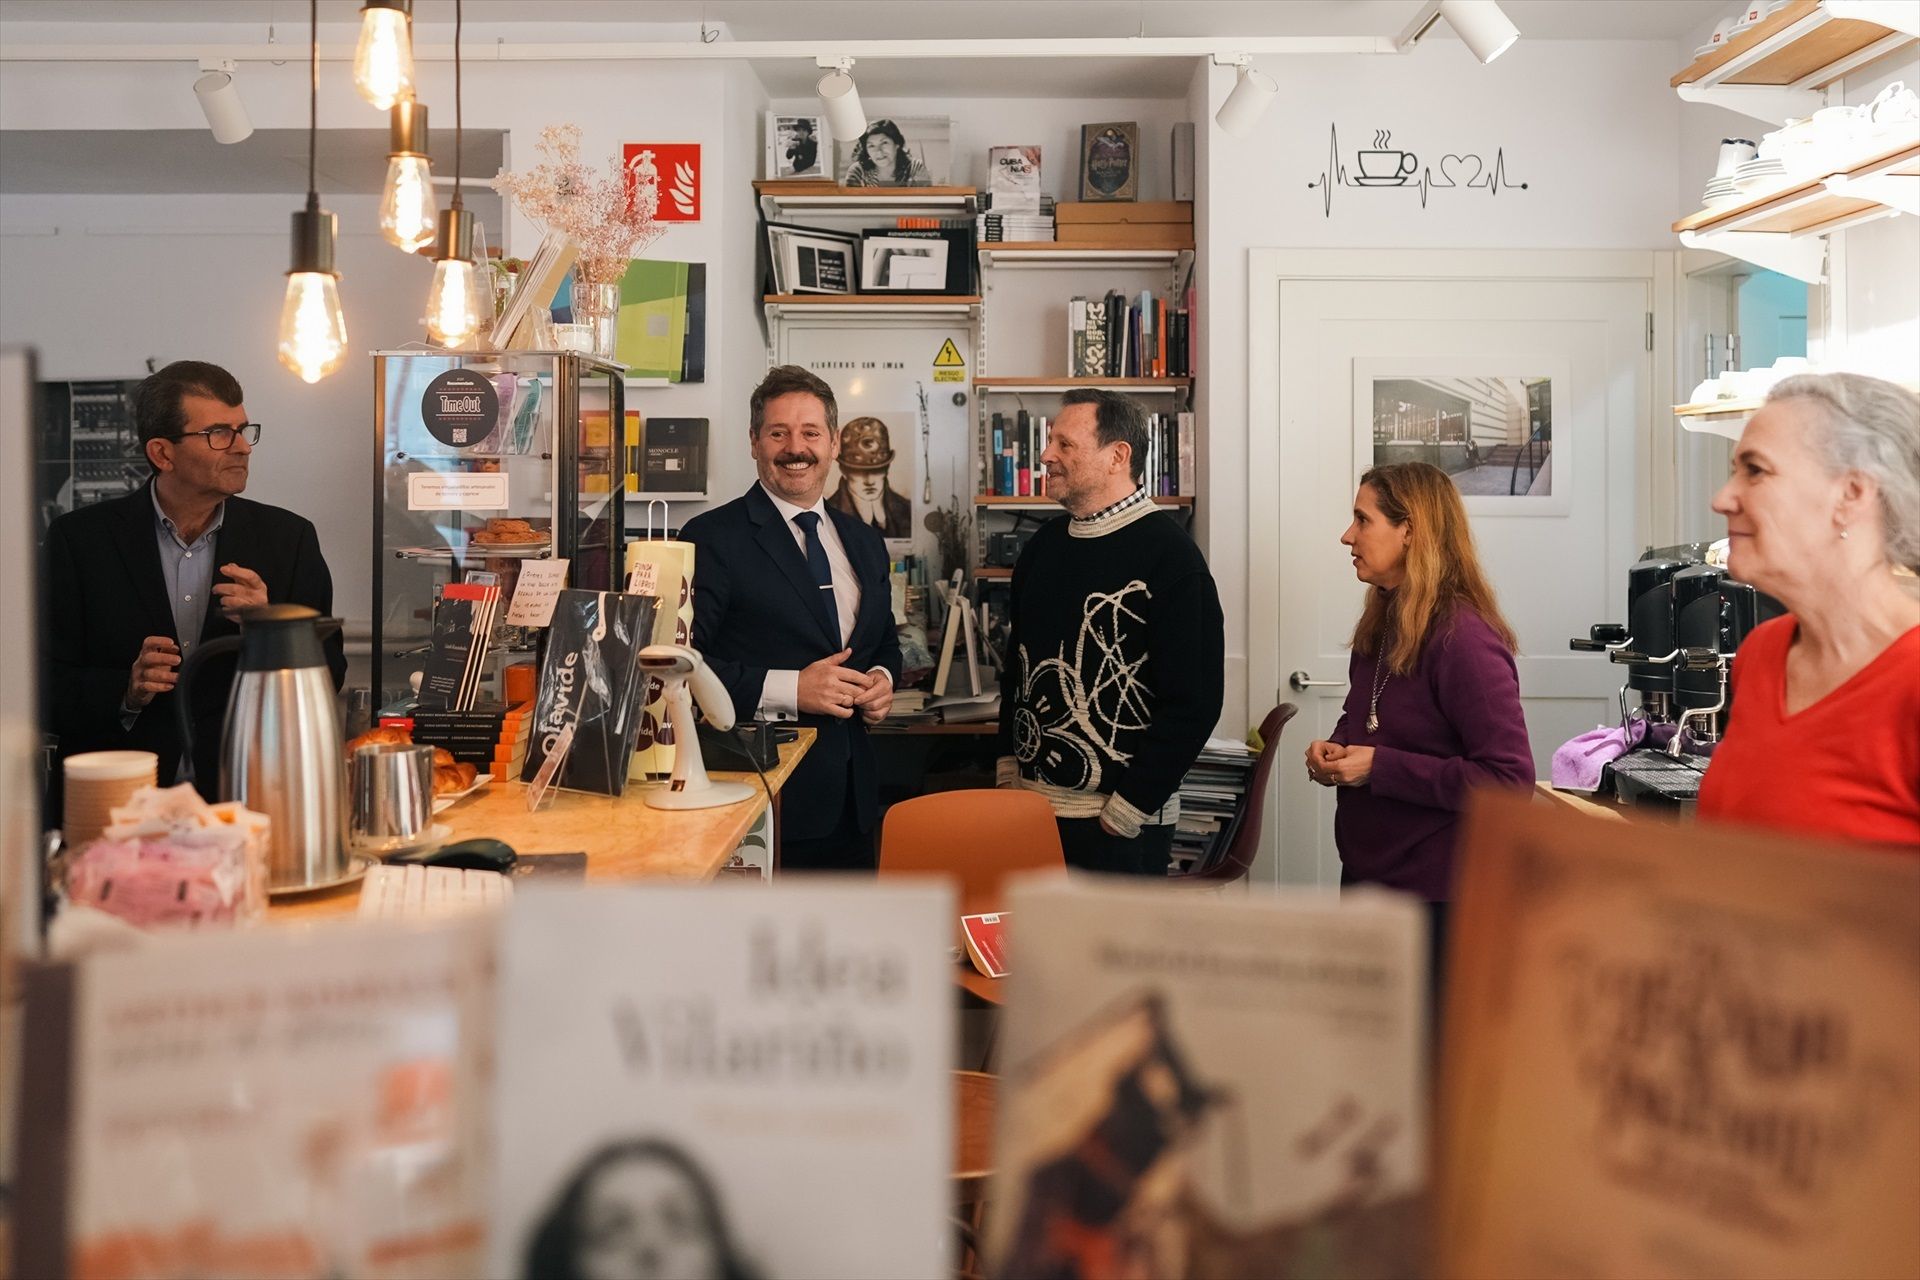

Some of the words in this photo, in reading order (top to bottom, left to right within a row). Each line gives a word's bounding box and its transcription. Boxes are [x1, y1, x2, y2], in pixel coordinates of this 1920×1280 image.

[1000, 158, 1023, 166] CUBA
[1010, 165, 1032, 173] NIAS
[862, 361, 876, 369] CON
